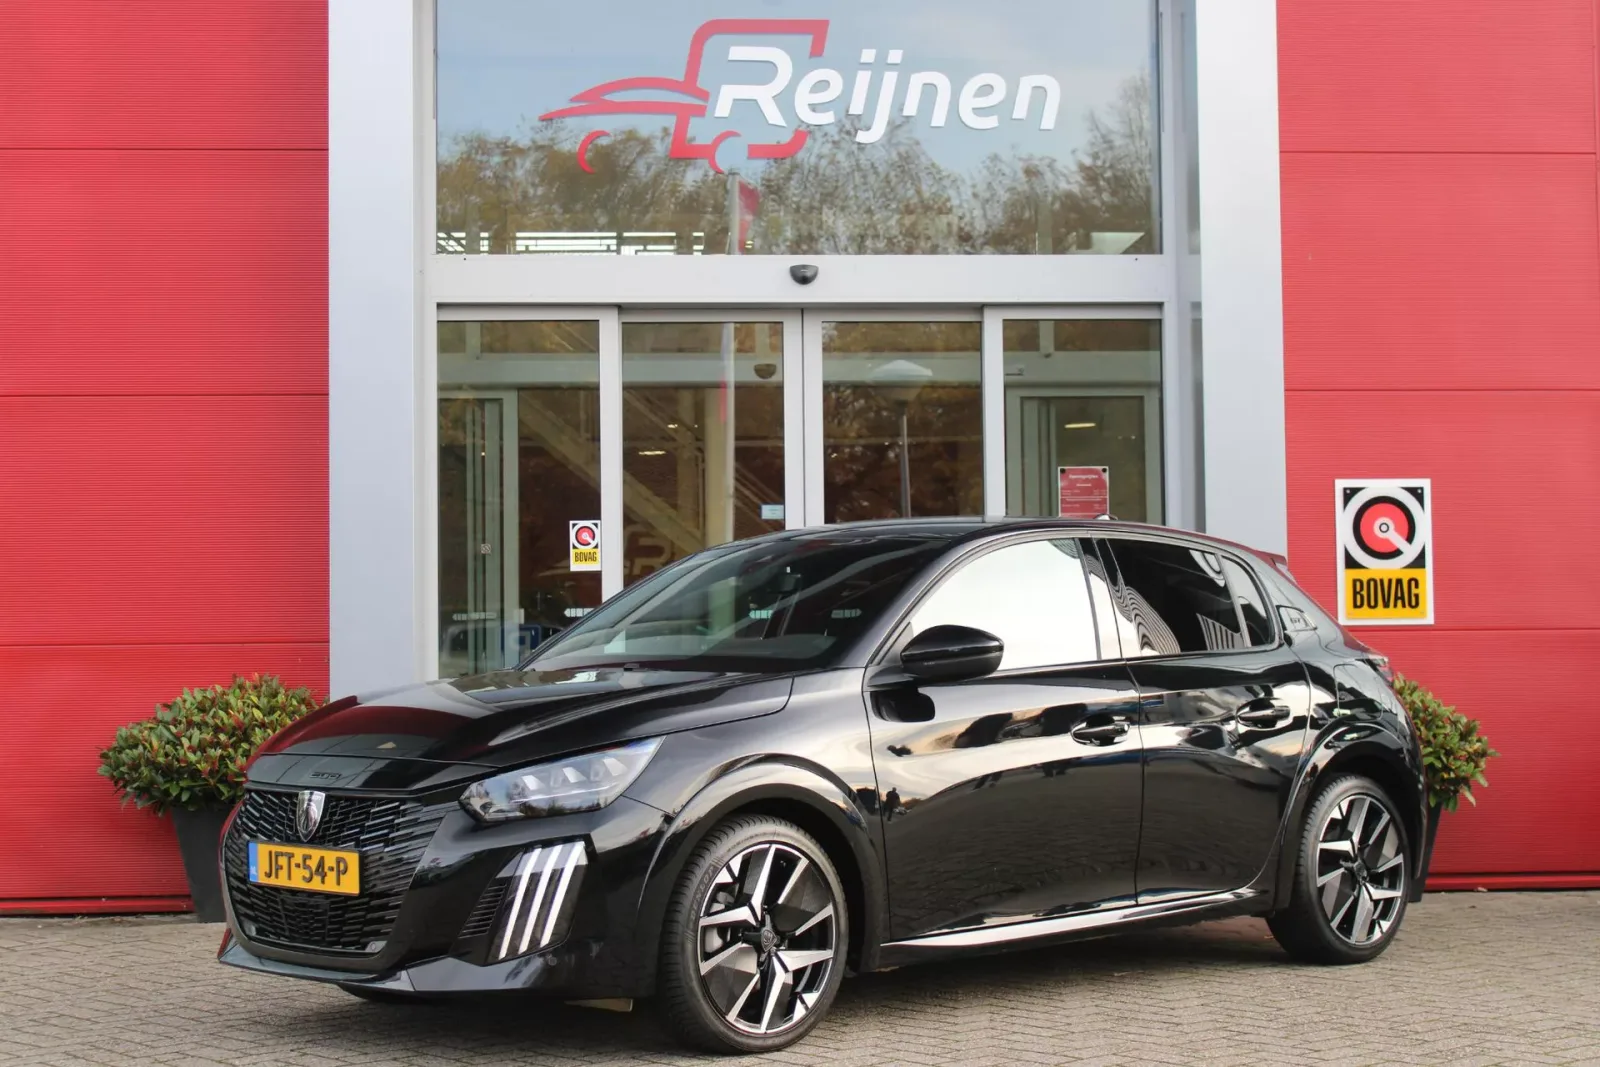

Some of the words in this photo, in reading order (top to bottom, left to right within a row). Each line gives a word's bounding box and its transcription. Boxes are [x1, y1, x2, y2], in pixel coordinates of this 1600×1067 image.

[714, 46, 1061, 143] Reijnen
[575, 551, 597, 562] BOVAG
[1352, 577, 1420, 609] BOVAG
[264, 850, 348, 886] JFT-54-P
